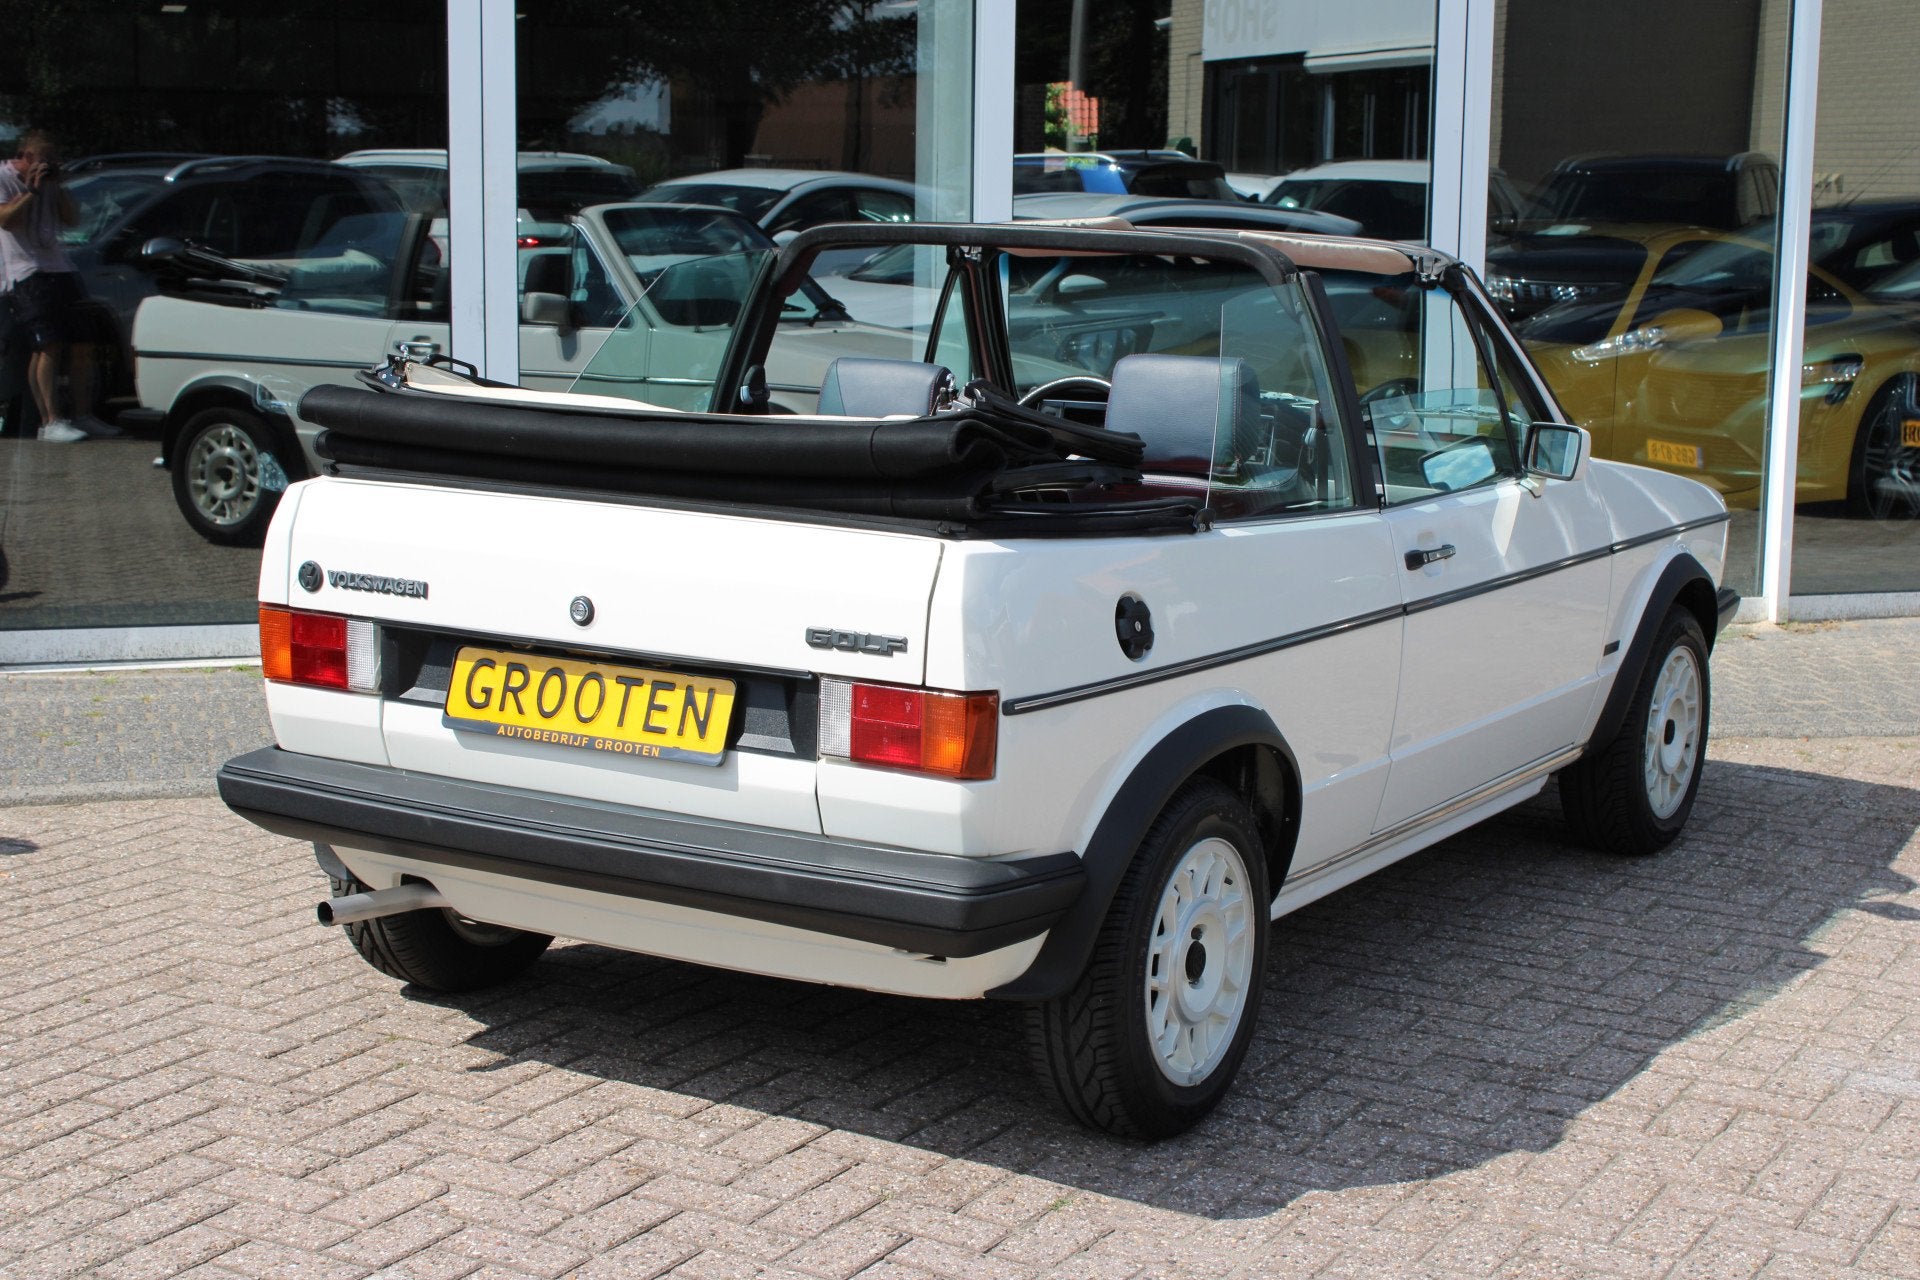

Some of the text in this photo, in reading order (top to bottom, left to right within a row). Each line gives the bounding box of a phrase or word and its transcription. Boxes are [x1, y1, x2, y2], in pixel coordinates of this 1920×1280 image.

[328, 569, 429, 600] VOLKSWAGEN
[805, 626, 908, 657] GOLF
[465, 658, 716, 740] GROOTEN
[496, 725, 661, 758] AUTOBEDRIJF GROOTEN
